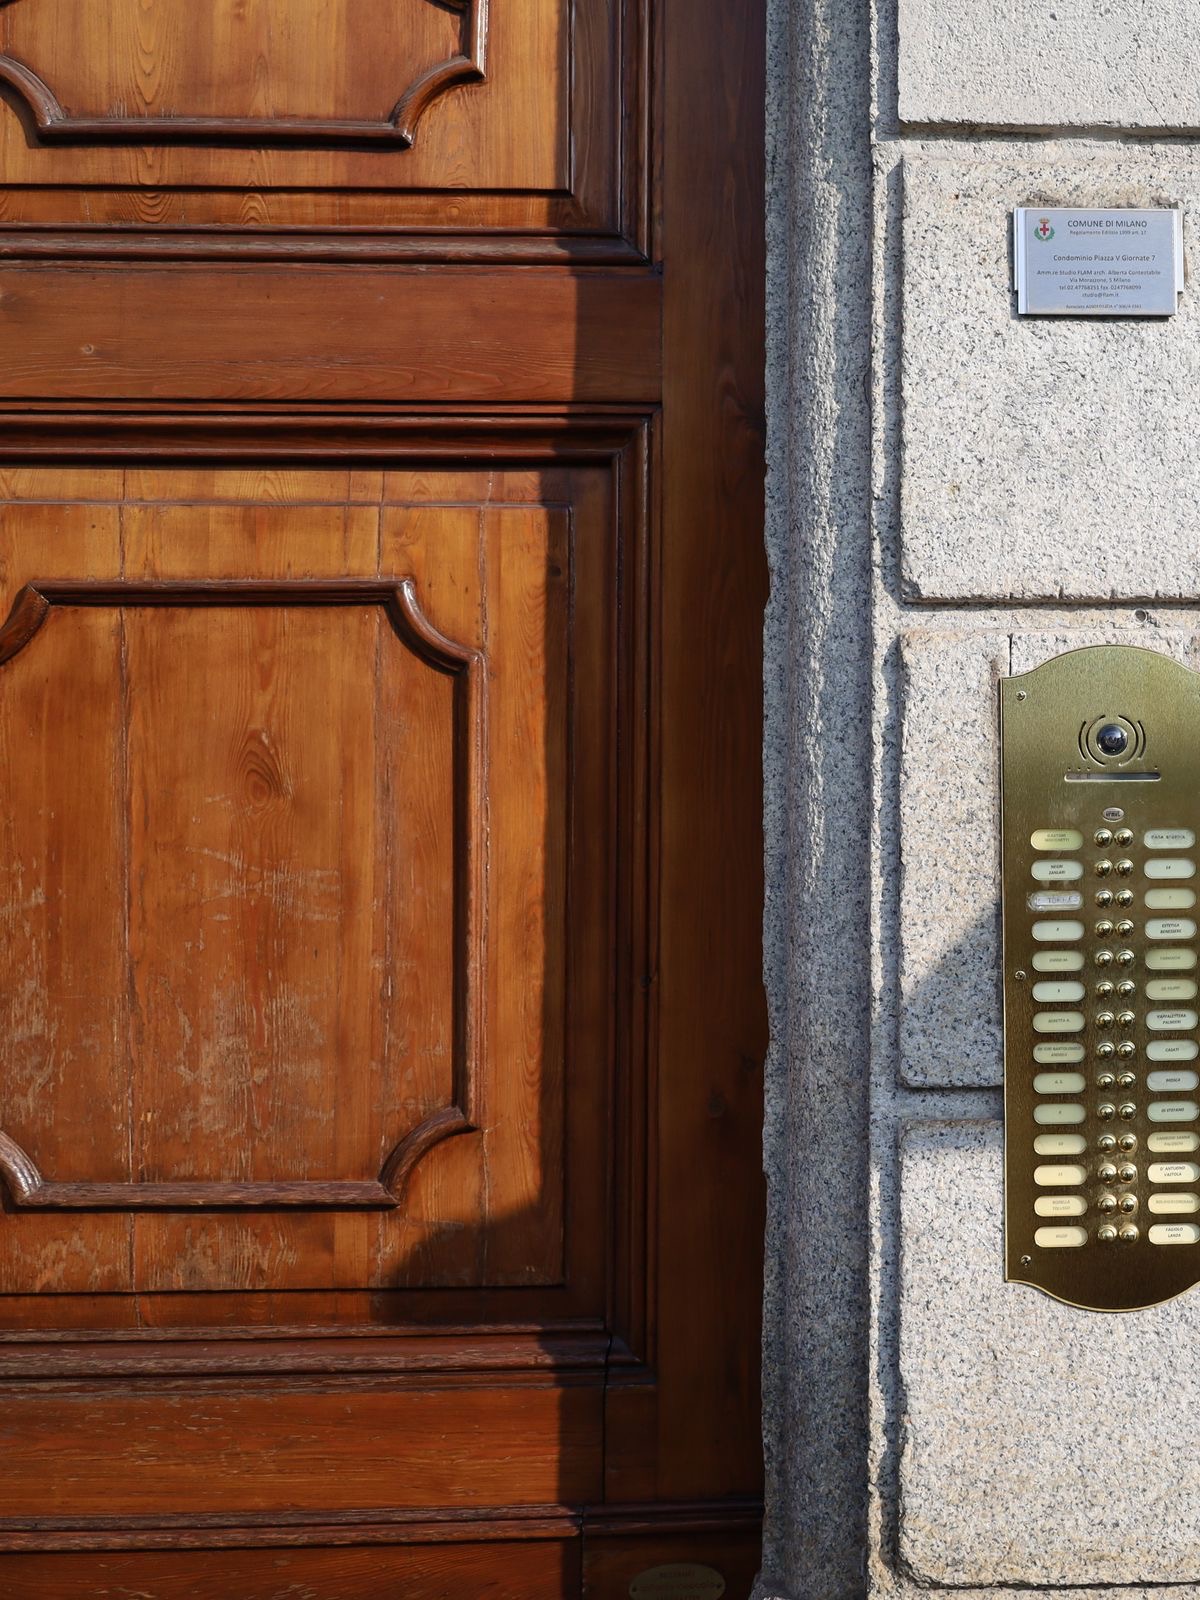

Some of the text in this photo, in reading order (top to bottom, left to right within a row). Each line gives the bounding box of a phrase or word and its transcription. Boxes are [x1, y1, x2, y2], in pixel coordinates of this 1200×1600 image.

[1067, 220, 1148, 228] COMUNE DI MILANO
[1053, 254, 1093, 262] Condominio
